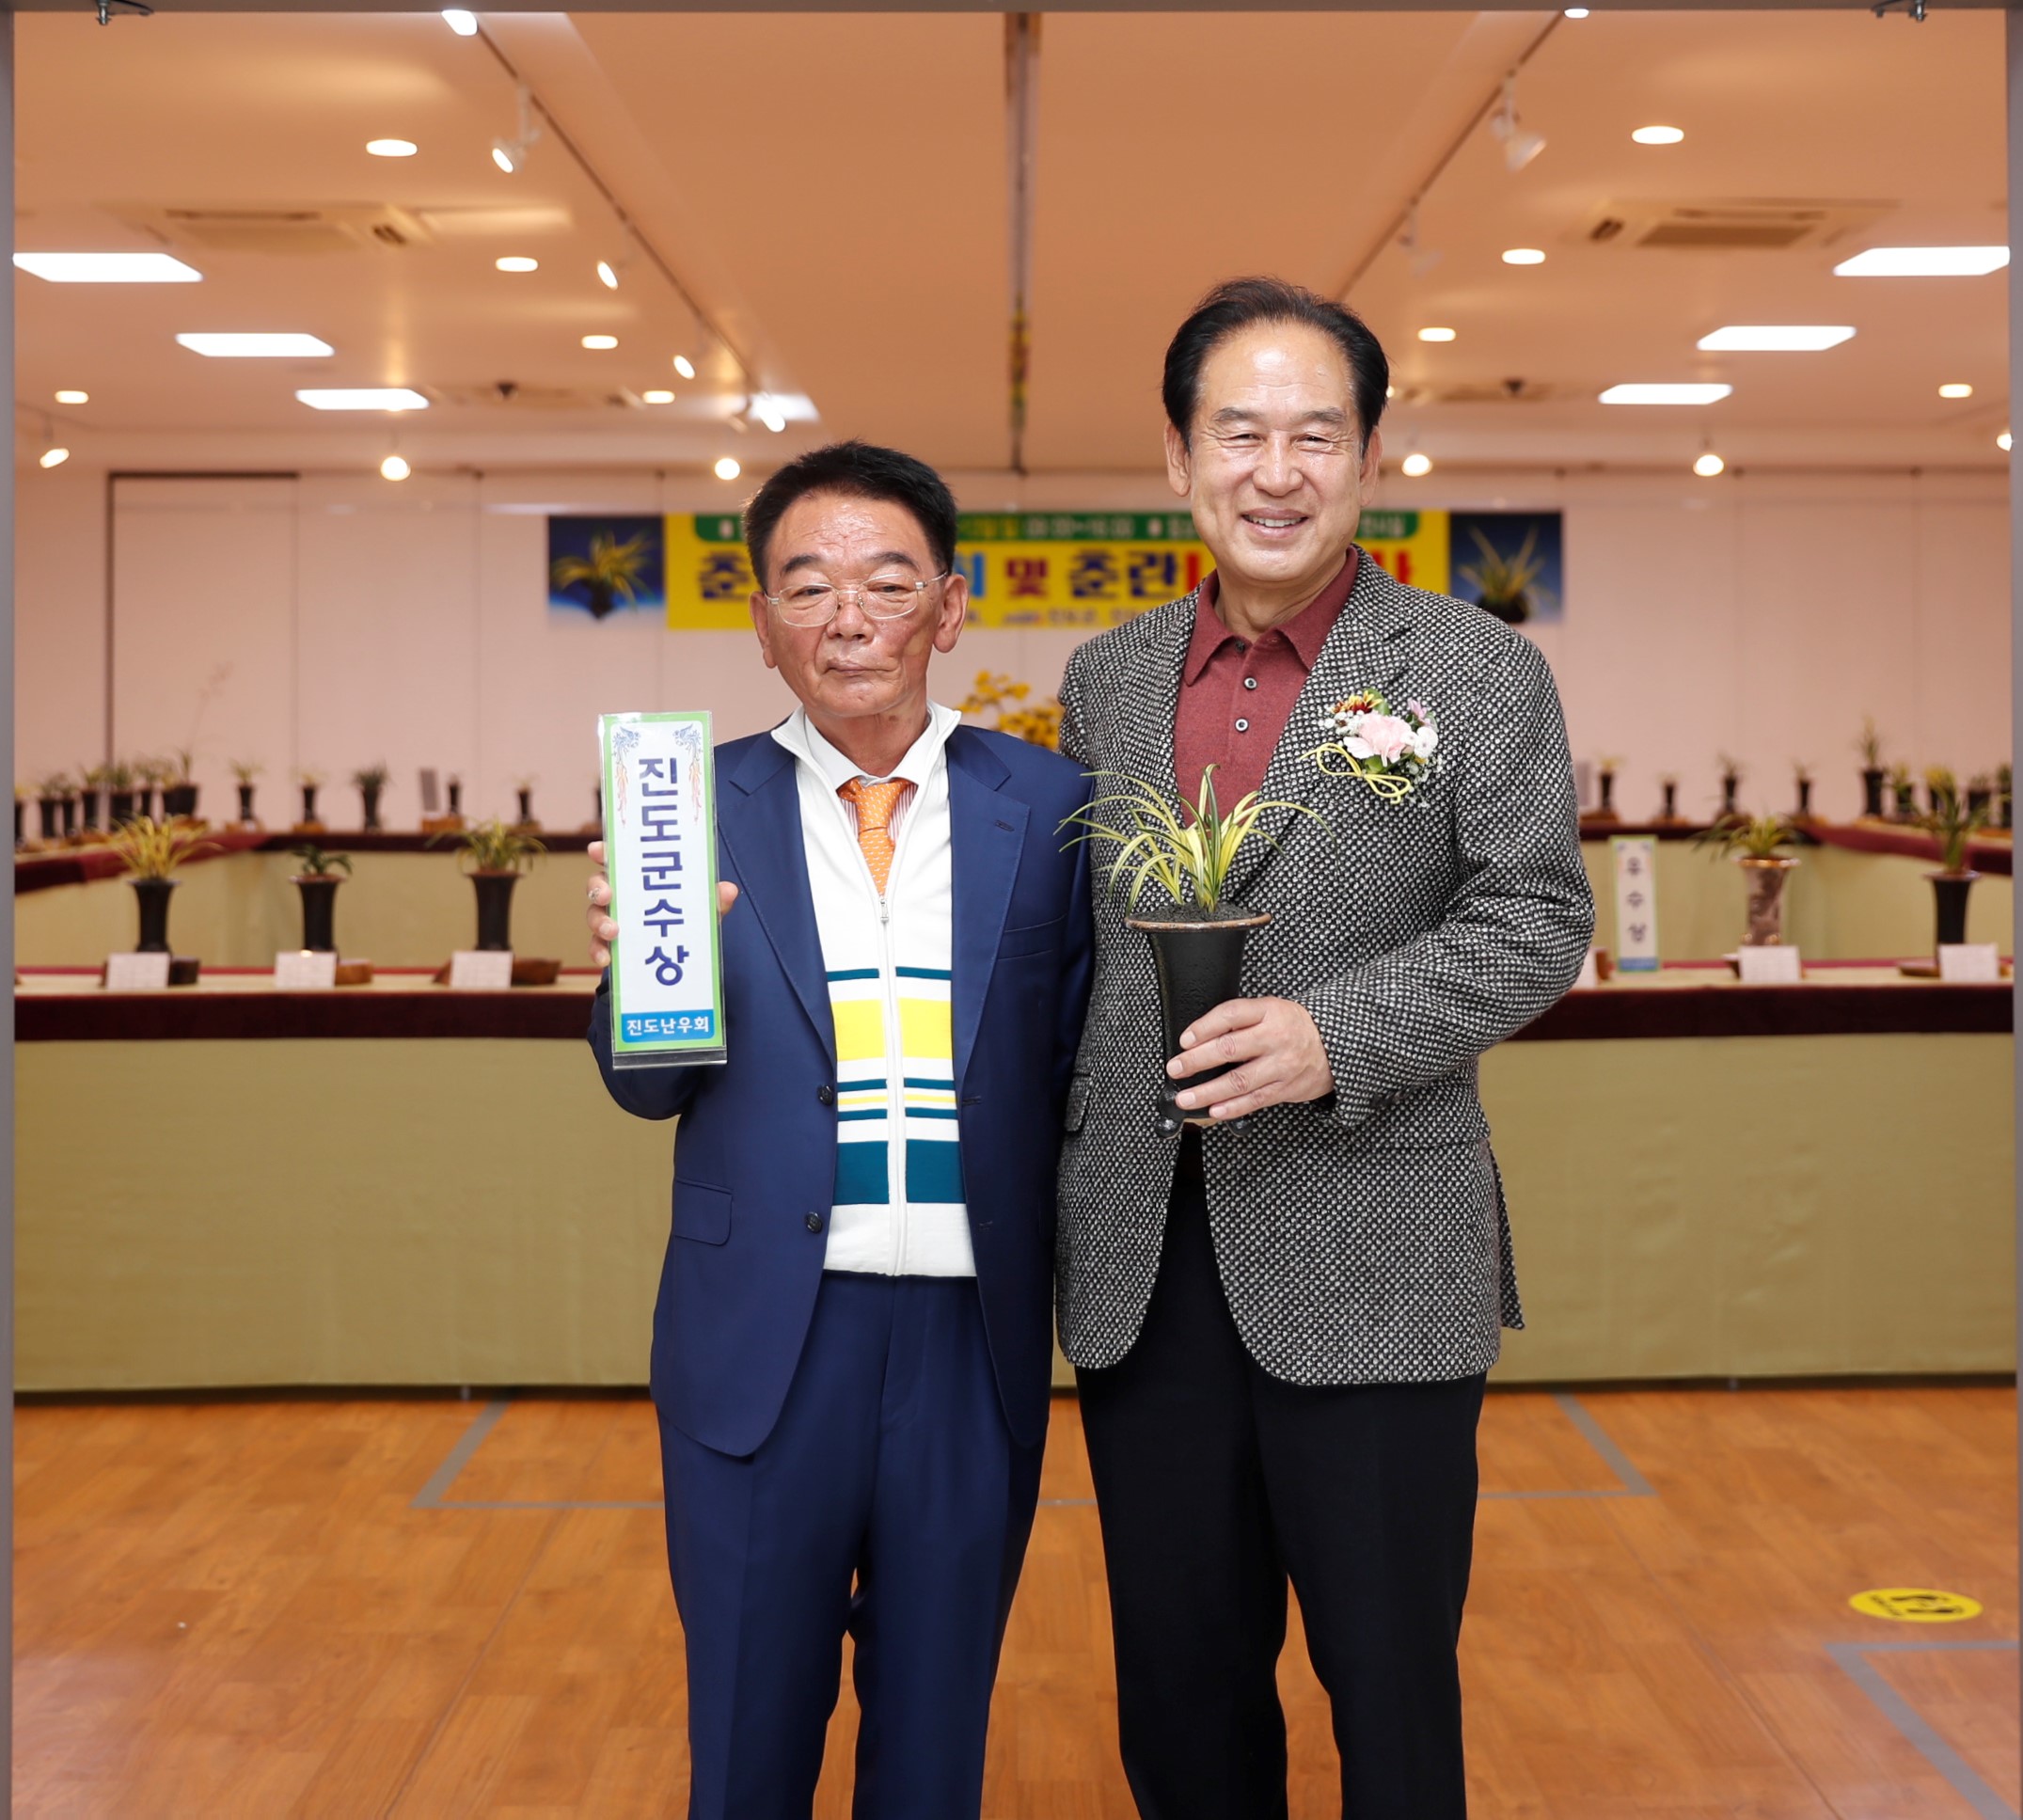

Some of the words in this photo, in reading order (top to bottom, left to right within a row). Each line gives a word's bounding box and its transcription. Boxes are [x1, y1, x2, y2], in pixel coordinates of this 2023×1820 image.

[1005, 557, 1049, 599] 및
[639, 757, 689, 986] 진도군수상
[626, 1016, 709, 1037] 진도난우회
